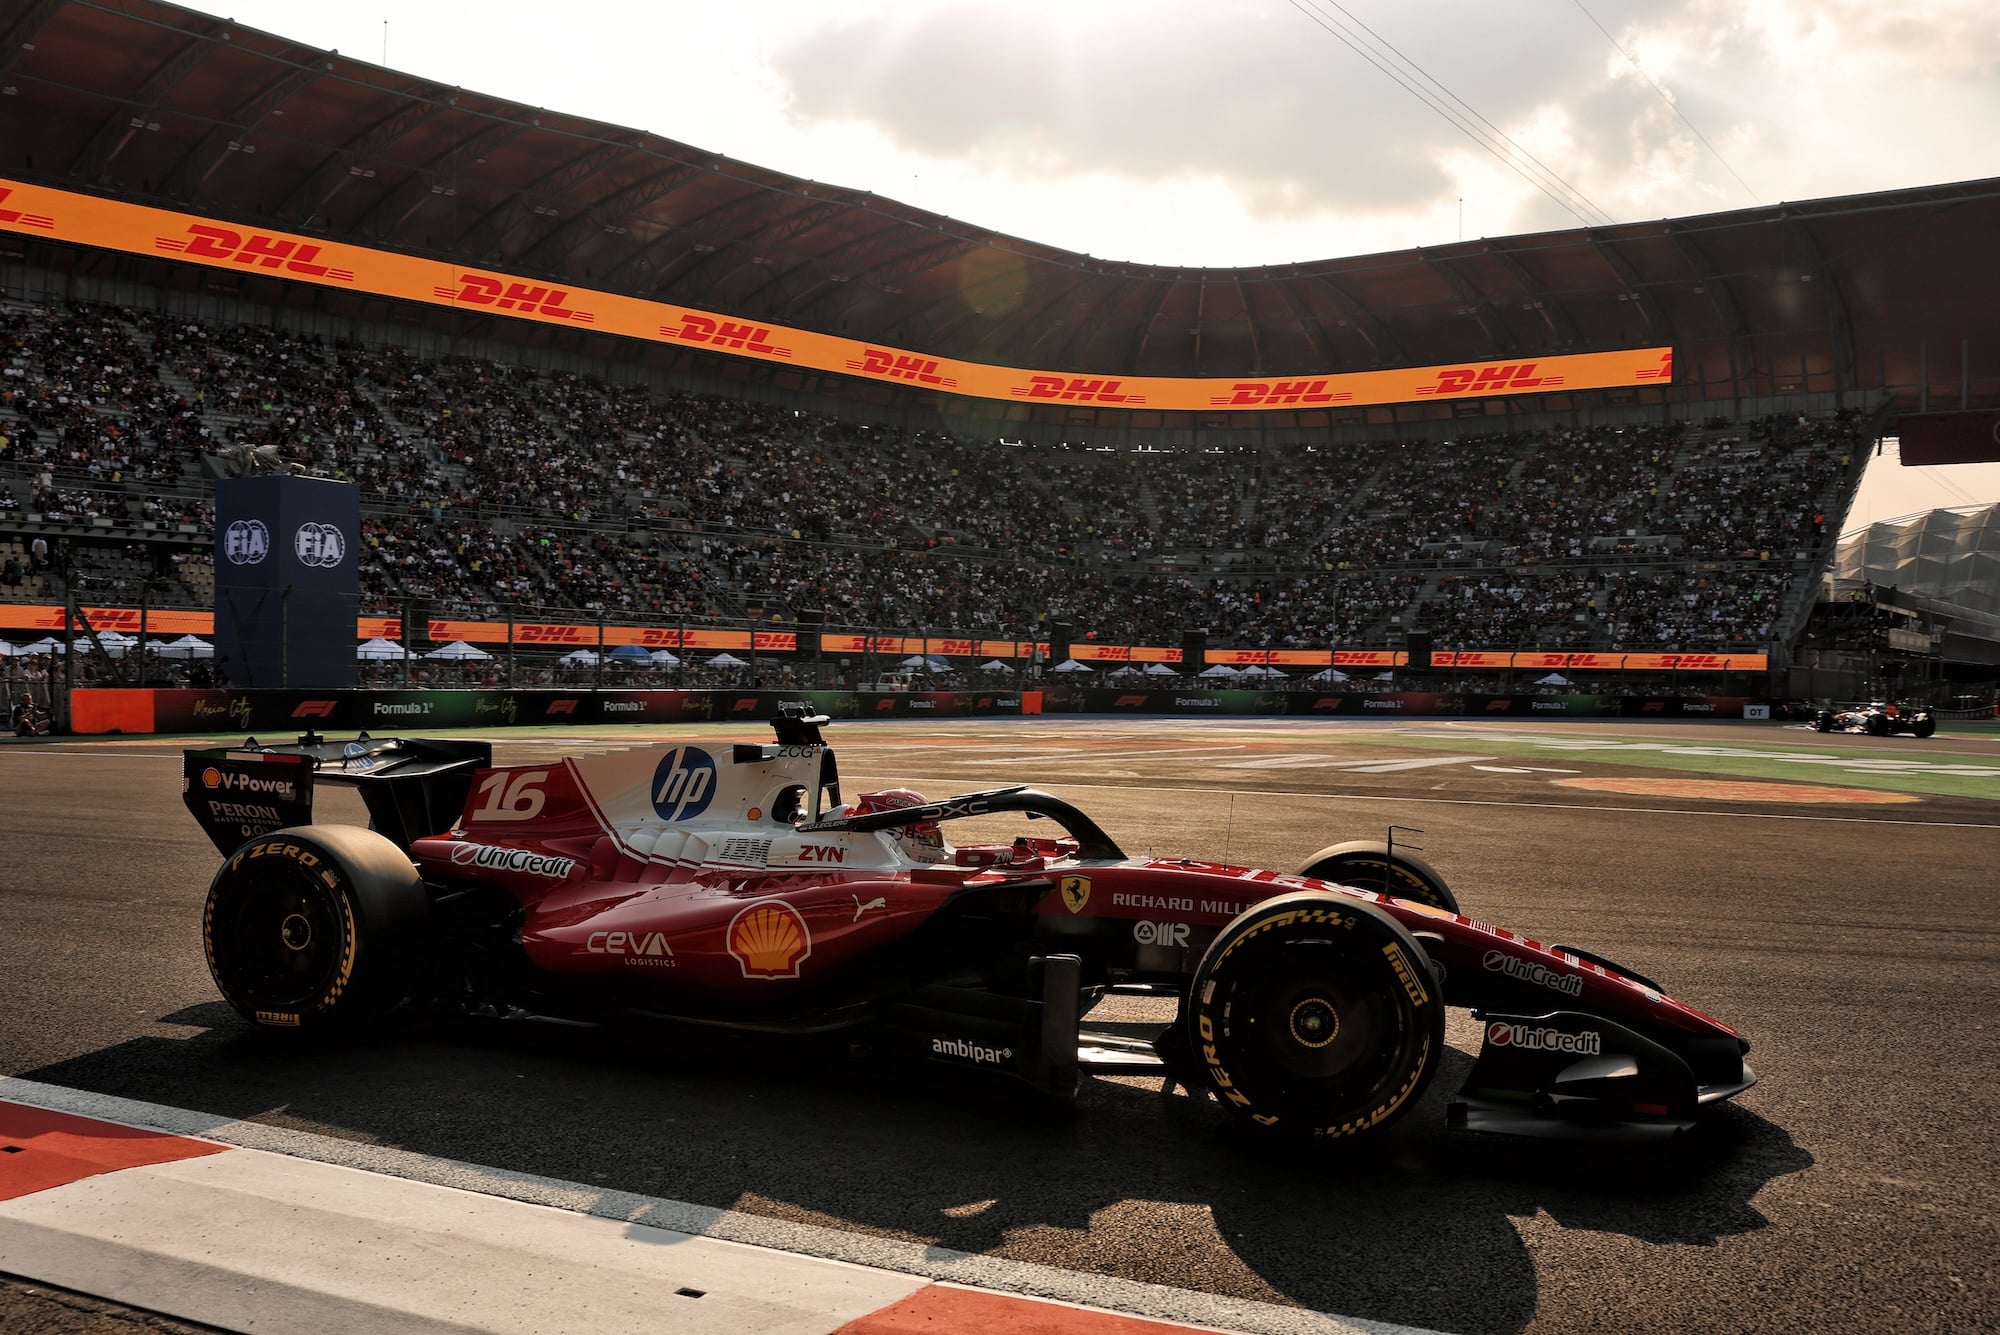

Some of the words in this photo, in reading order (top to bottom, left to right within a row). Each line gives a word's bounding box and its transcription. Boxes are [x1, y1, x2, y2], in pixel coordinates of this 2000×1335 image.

[184, 223, 328, 277] DHL
[456, 274, 578, 318] DHL
[677, 314, 775, 354] DHL
[861, 349, 944, 384] DHL
[1027, 376, 1128, 402] DHL
[1435, 364, 1543, 395] DHL
[1228, 380, 1334, 404] DHL
[520, 626, 580, 642] DHL
[643, 630, 697, 645] DHL
[1235, 652, 1281, 662] DHL
[1334, 653, 1380, 663] DHL
[1433, 654, 1485, 665] DHL
[1543, 654, 1599, 666] DHL
[1660, 656, 1720, 667] DHL
[374, 702, 421, 715] Formula
[604, 701, 639, 712] Formula
[1175, 697, 1212, 707] Formula
[1363, 699, 1396, 709] Formula
[221, 772, 294, 793] V-Power
[471, 770, 549, 821] 16
[208, 800, 281, 820] PERONI
[250, 842, 320, 867] ZERO
[476, 846, 574, 879] UniCredit
[798, 845, 845, 863] ZYN
[993, 852, 1014, 864] ZYN
[1112, 892, 1194, 911] RICHARD
[624, 957, 677, 968] LOGISTICS
[1382, 941, 1429, 1007] PIRELLI
[1504, 958, 1583, 996] UniCredit
[1511, 1026, 1600, 1055] UniCredit
[1199, 1014, 1251, 1108] ZERO
